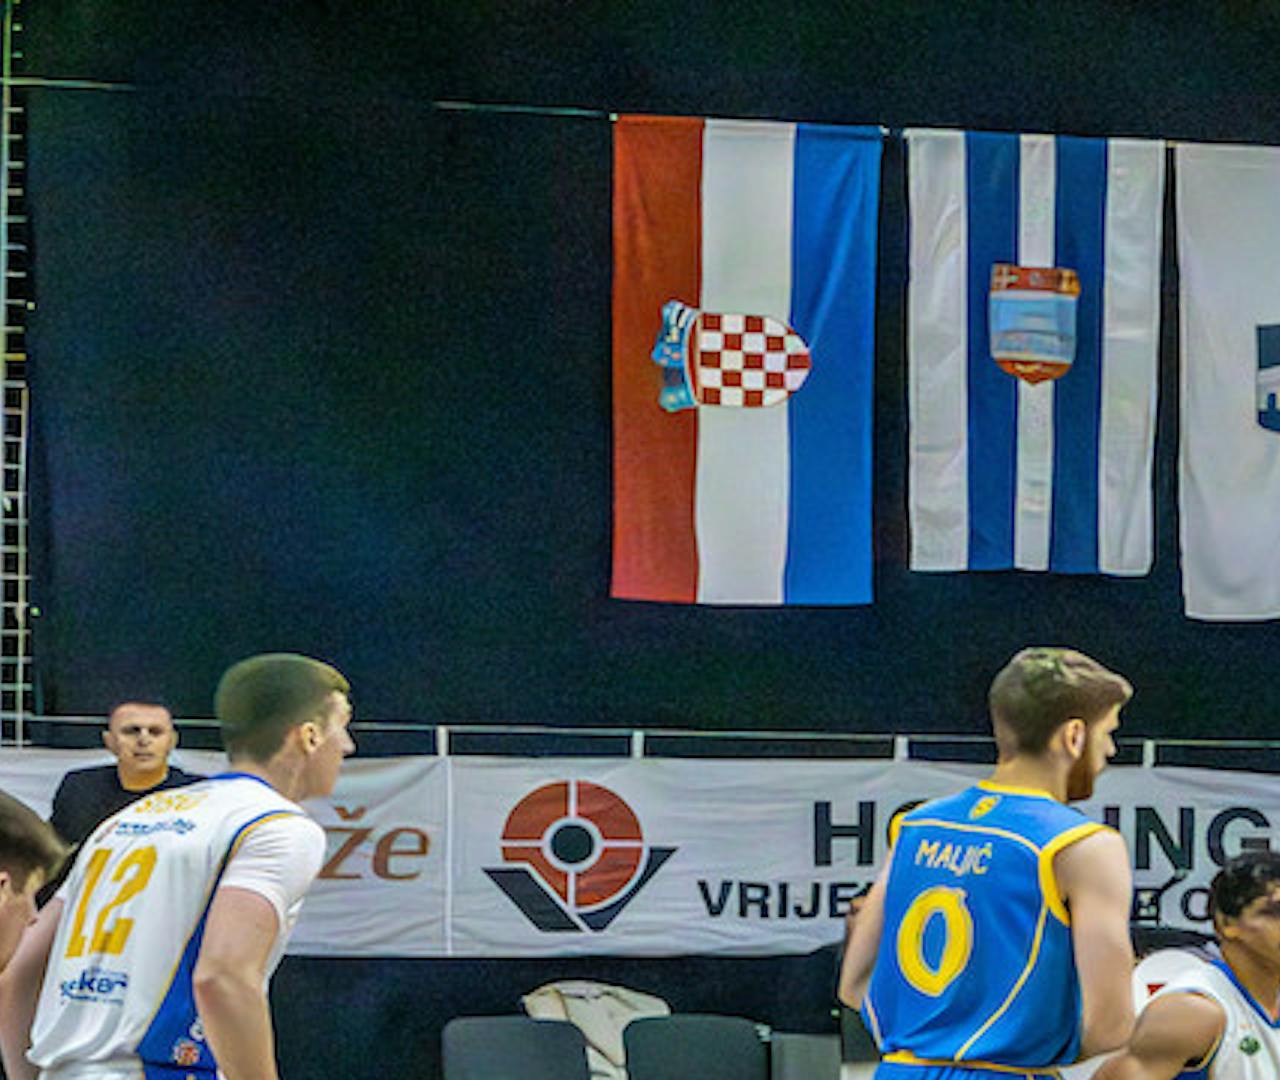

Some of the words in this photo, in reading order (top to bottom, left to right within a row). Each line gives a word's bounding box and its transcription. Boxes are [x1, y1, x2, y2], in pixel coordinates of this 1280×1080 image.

[320, 806, 430, 881] že
[64, 844, 158, 958] 12
[897, 886, 975, 997] 0
